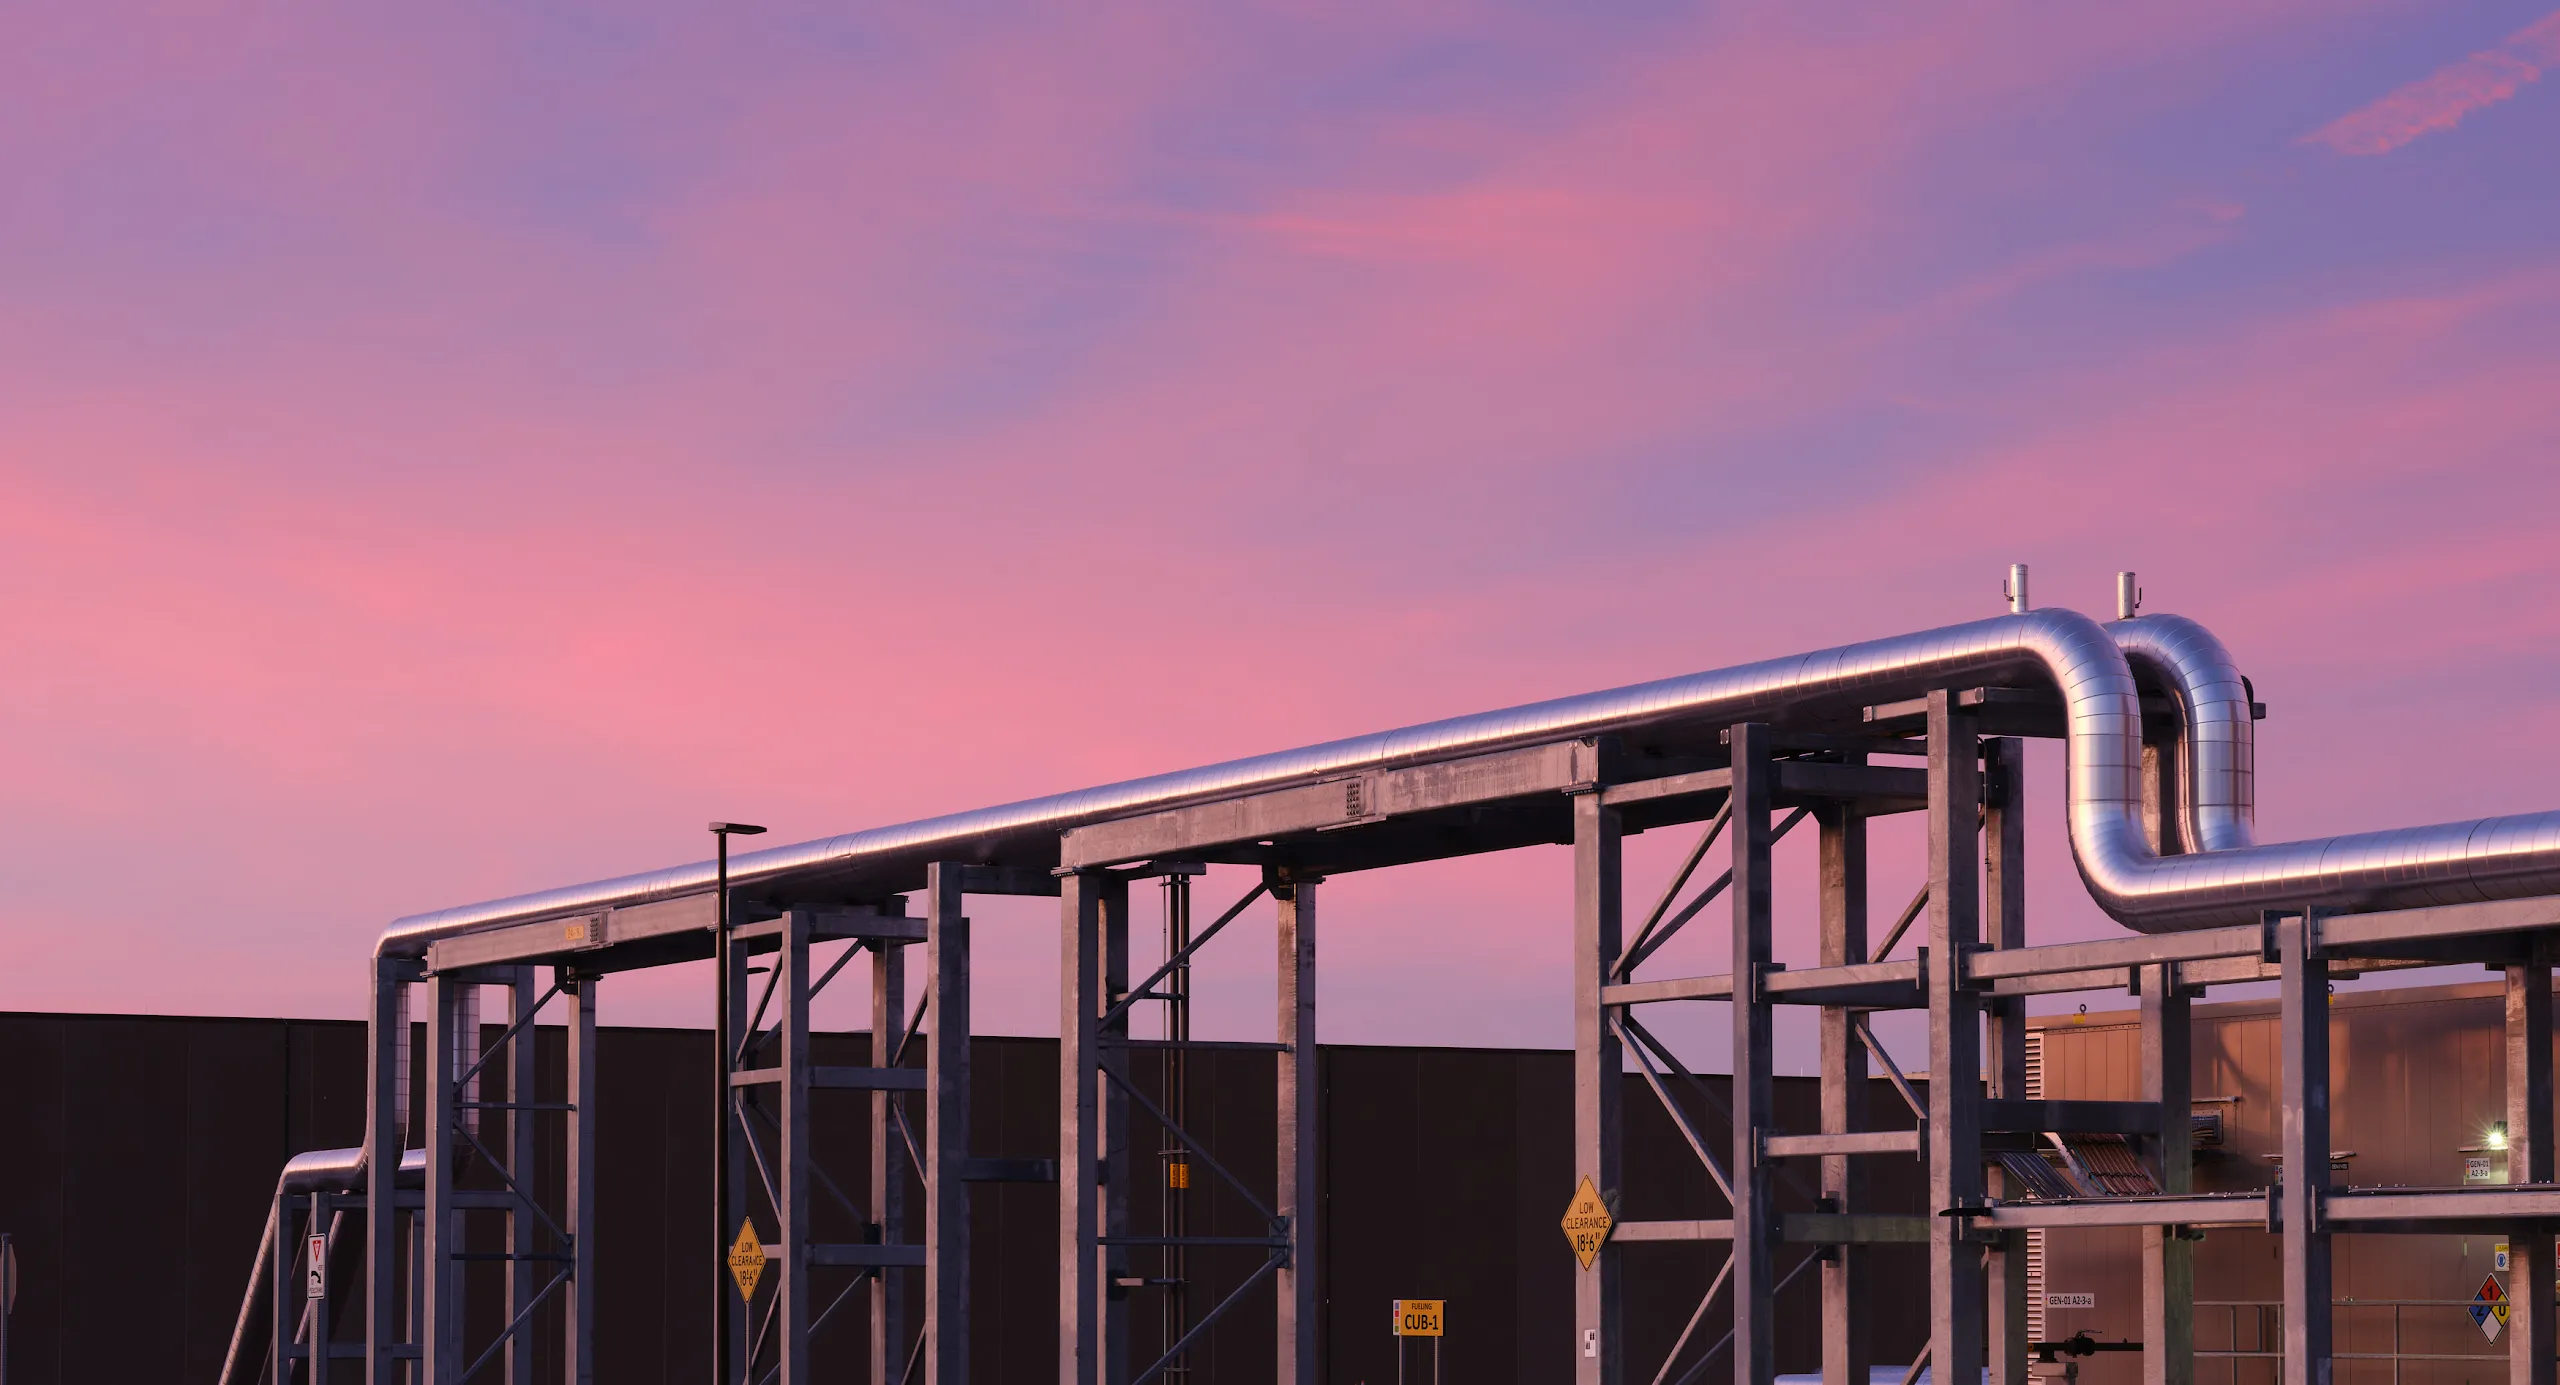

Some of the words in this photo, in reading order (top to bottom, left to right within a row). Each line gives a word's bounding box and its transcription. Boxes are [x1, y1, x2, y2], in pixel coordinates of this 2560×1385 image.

[2470, 1160, 2489, 1168] GEN-01
[1579, 1202, 1594, 1214] LOW
[1566, 1216, 1607, 1230] CLEARANCE
[741, 1242, 753, 1253] LOW
[731, 1255, 763, 1267] CLEARANCE
[2487, 1285, 2493, 1300] 1
[1411, 1302, 1432, 1310] FUELING
[2049, 1295, 2071, 1305] GEN-01
[2072, 1295, 2092, 1305] A2-3-a
[2476, 1305, 2484, 1317] 2
[2498, 1305, 2506, 1317] 0
[1404, 1314, 1439, 1330] CUB-1
